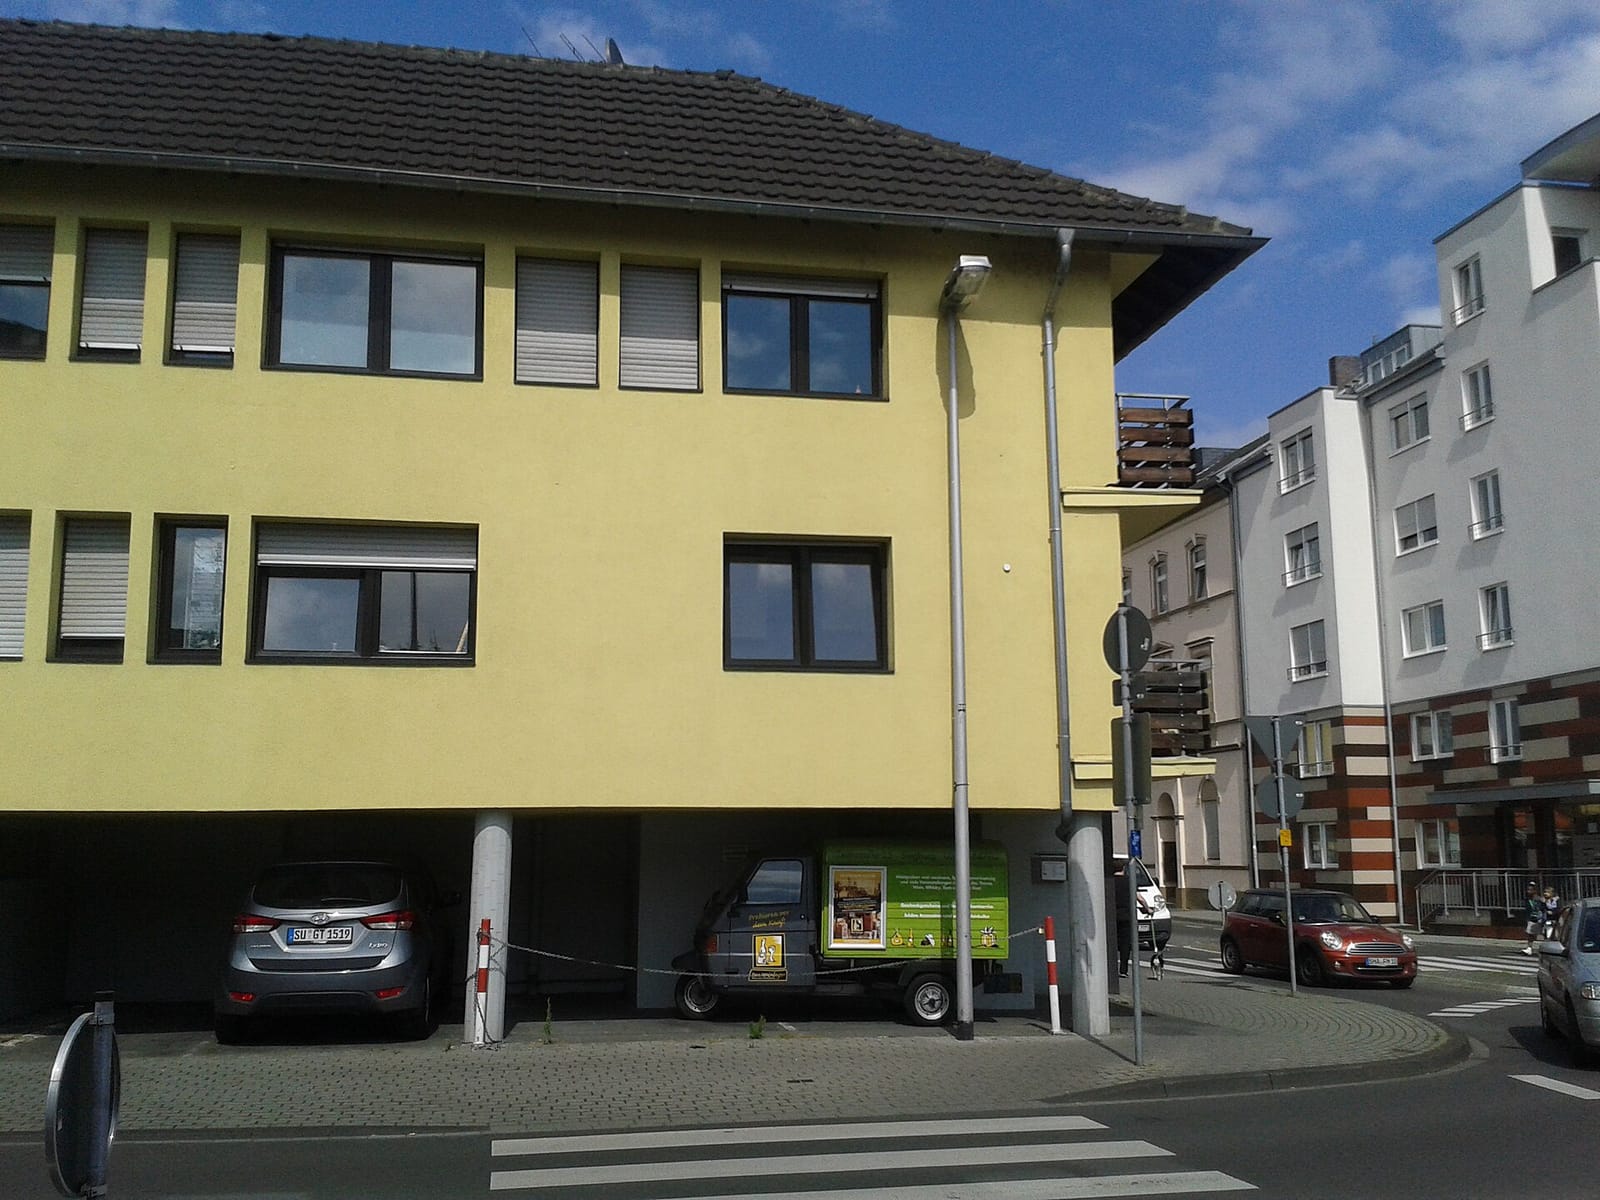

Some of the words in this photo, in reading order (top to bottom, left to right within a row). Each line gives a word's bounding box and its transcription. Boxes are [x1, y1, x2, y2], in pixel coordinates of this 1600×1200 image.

[294, 930, 306, 940] SU
[313, 929, 325, 939] GT
[327, 928, 350, 939] 1519
